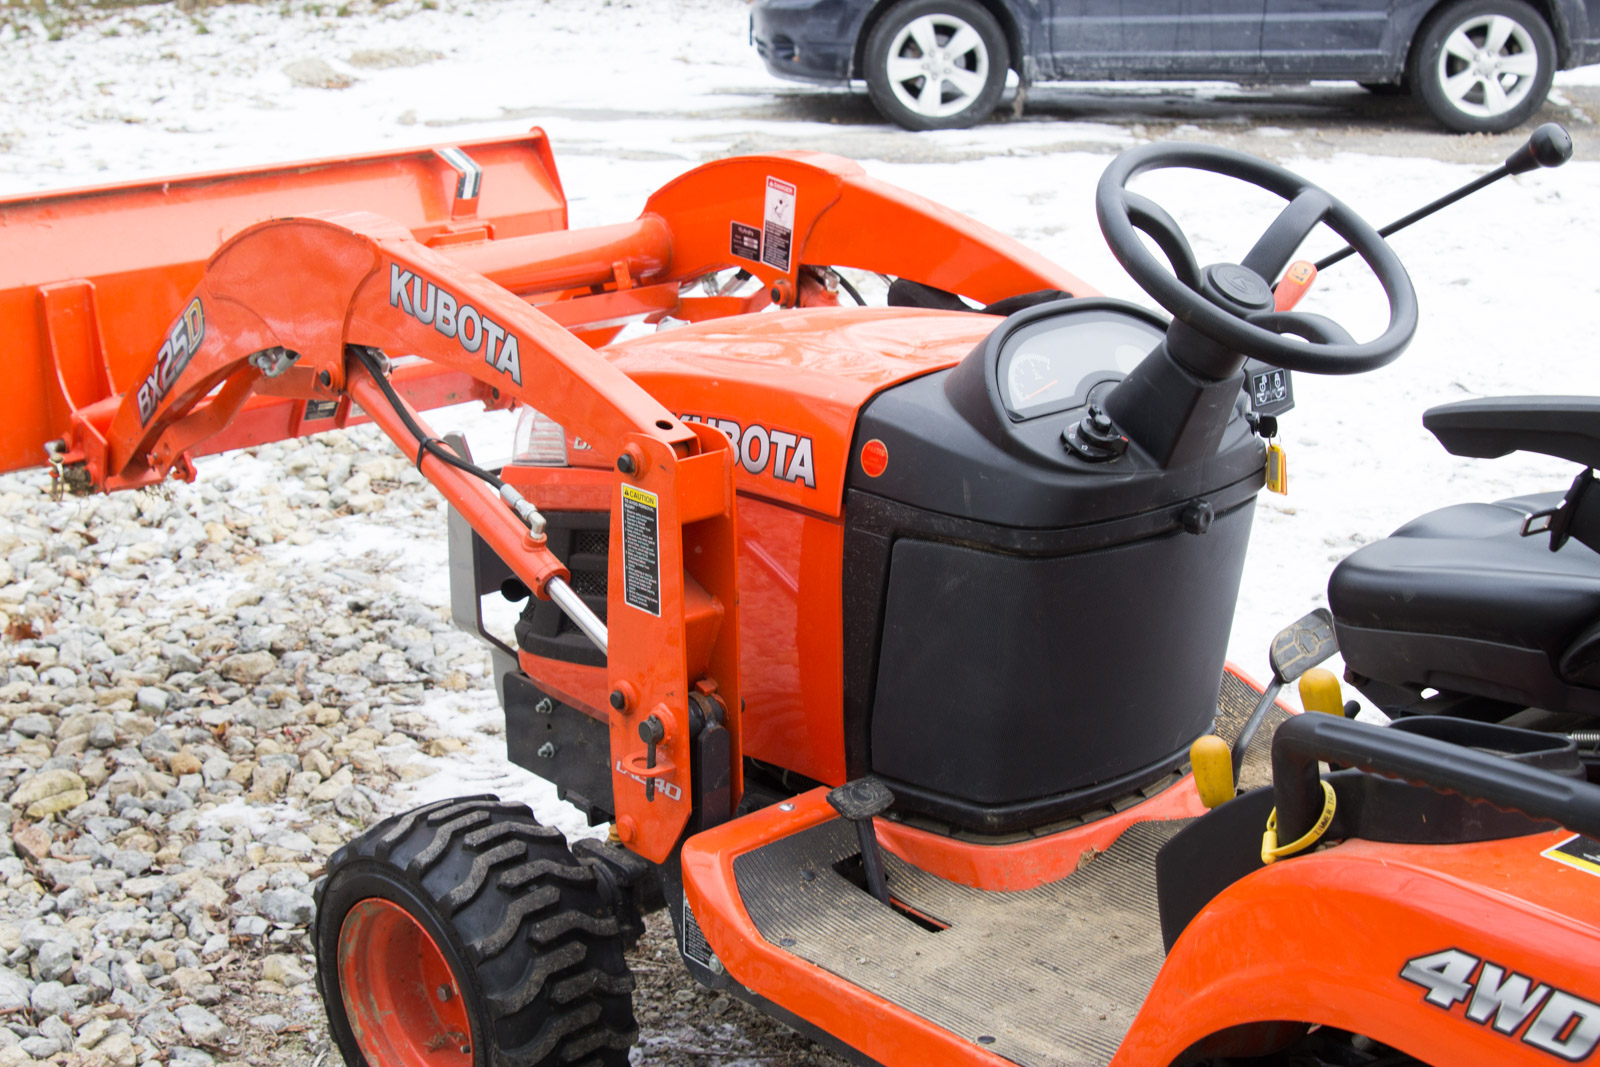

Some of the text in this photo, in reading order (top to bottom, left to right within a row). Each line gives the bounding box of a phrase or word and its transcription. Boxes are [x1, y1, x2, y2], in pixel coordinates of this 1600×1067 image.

[136, 296, 205, 430] BX25D
[389, 262, 522, 388] KUBOTA
[630, 490, 654, 505] CAUTION
[672, 412, 817, 490] BOTA
[615, 760, 682, 801] L40
[1399, 946, 1600, 1064] 4WD
